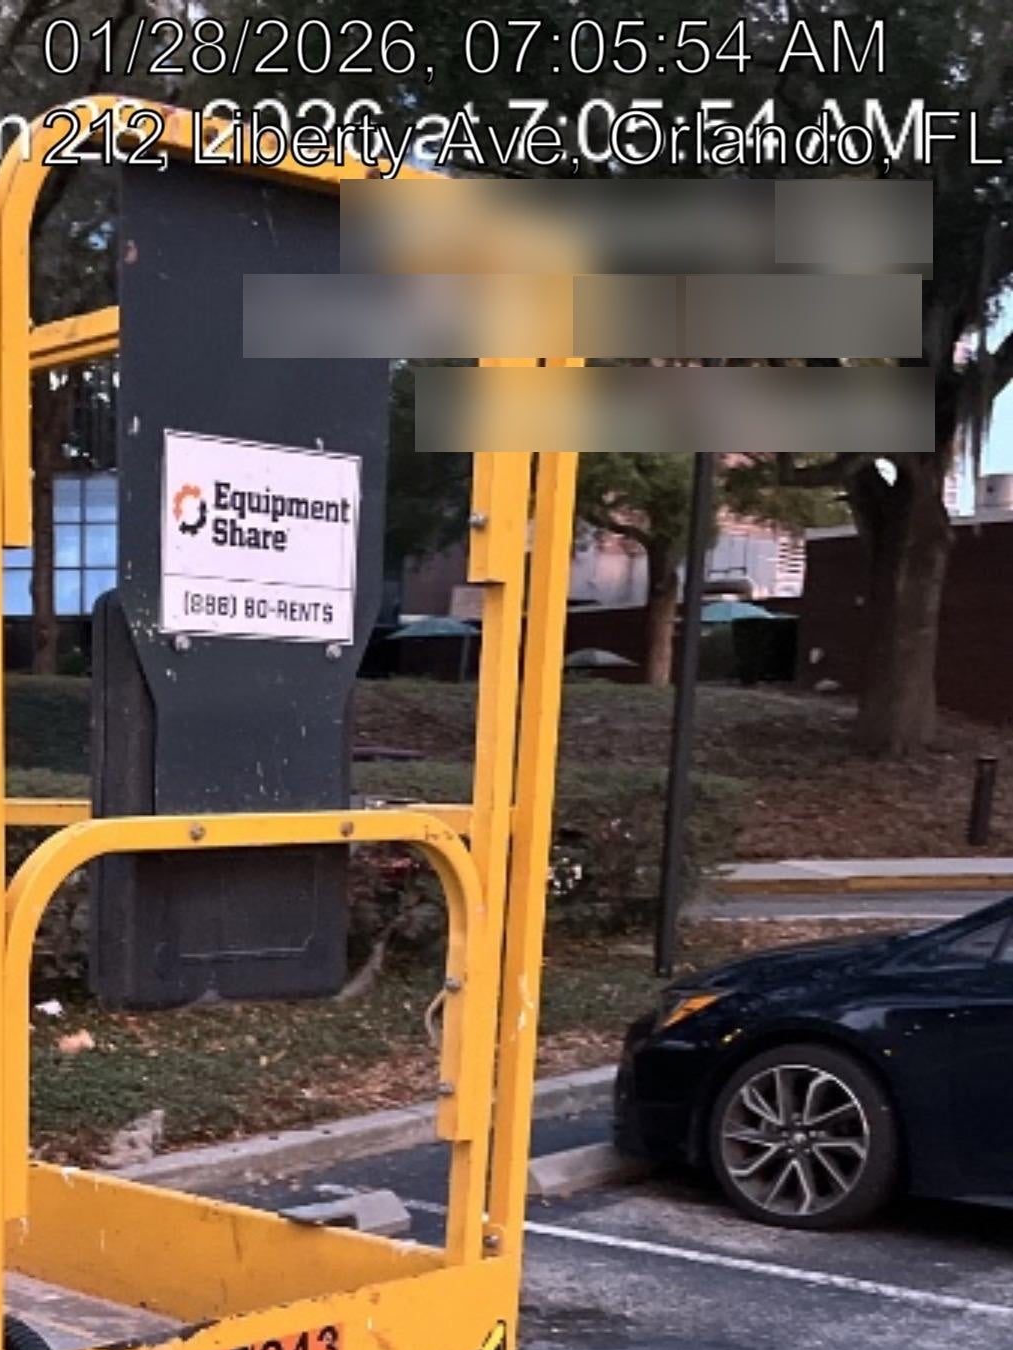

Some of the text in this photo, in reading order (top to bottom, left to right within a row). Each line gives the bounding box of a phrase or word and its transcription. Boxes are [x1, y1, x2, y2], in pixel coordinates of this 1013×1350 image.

[213, 481, 351, 523] Equipment
[212, 518, 288, 551] Share
[184, 590, 237, 618] (888)
